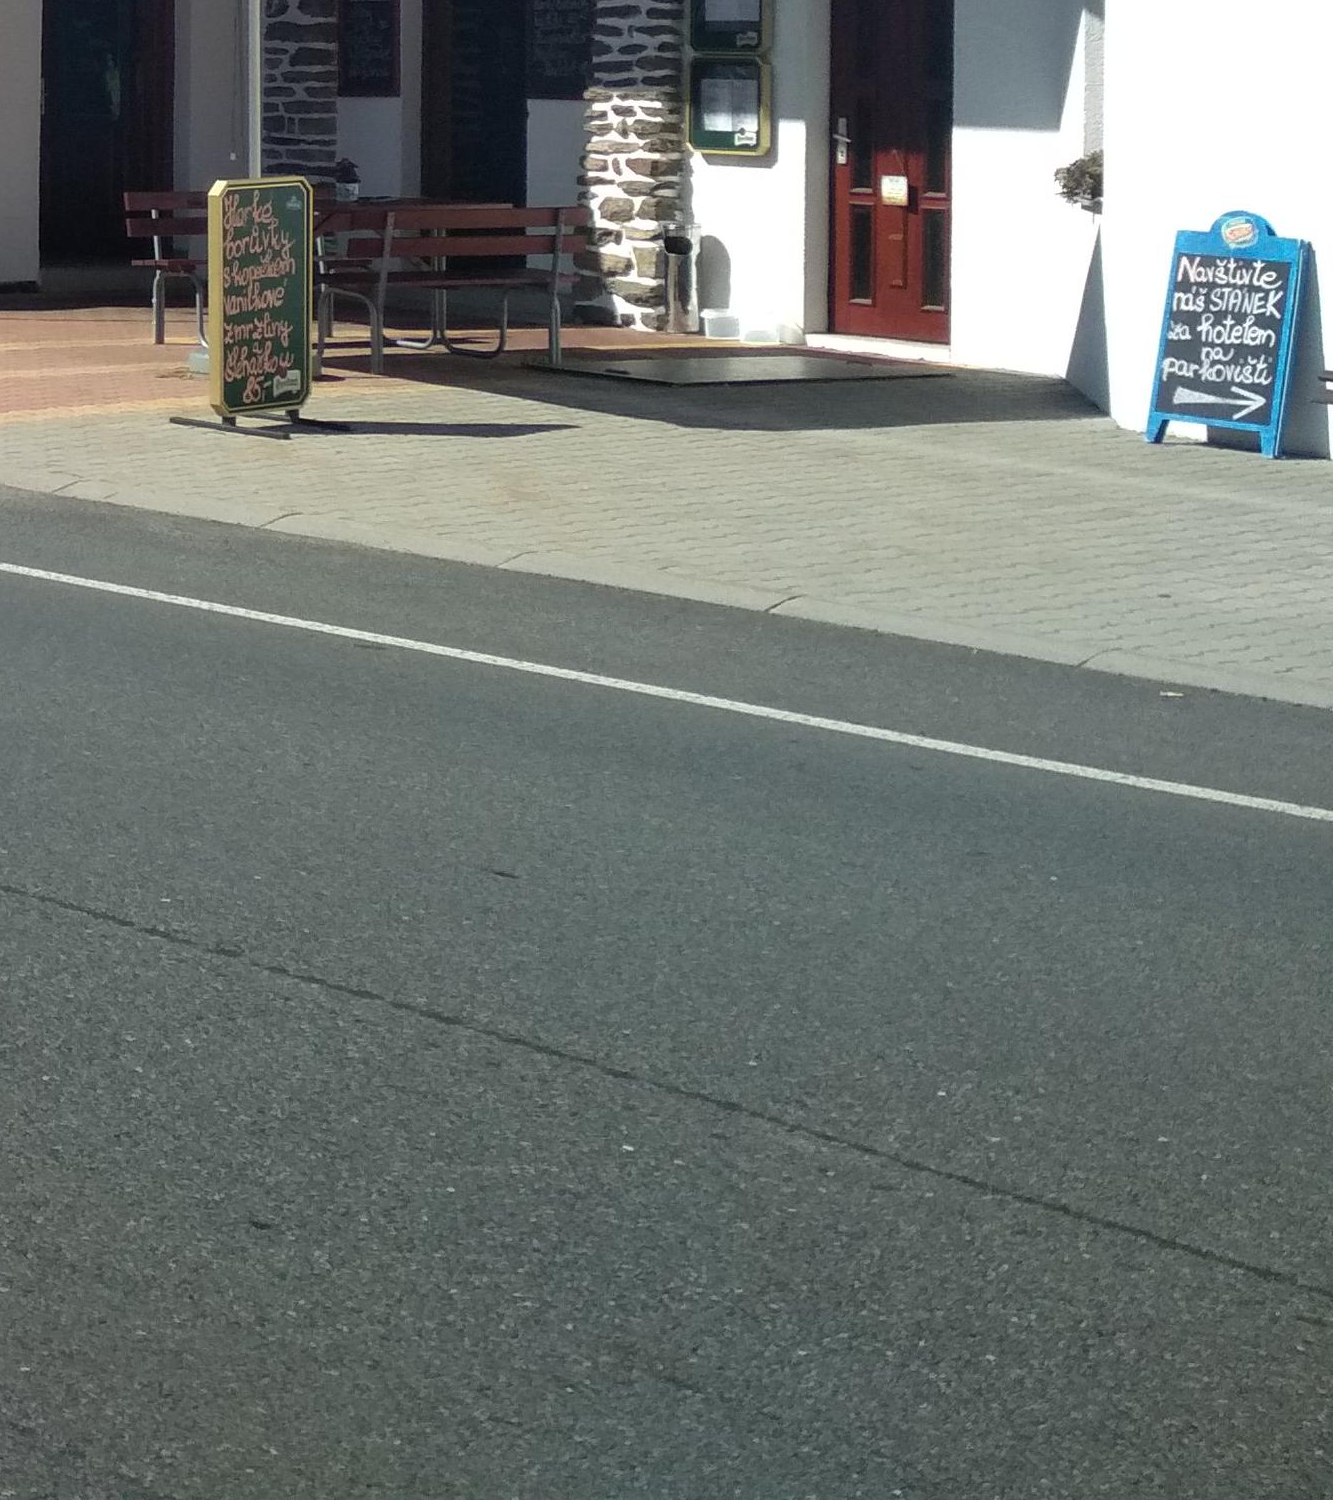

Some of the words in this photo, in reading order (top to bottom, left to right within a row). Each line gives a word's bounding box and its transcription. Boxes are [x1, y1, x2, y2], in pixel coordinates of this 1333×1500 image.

[1173, 286, 1208, 312] náš
[1196, 313, 1276, 348] hotelem
[1201, 346, 1235, 361] na
[1162, 354, 1273, 385] parkovišti
